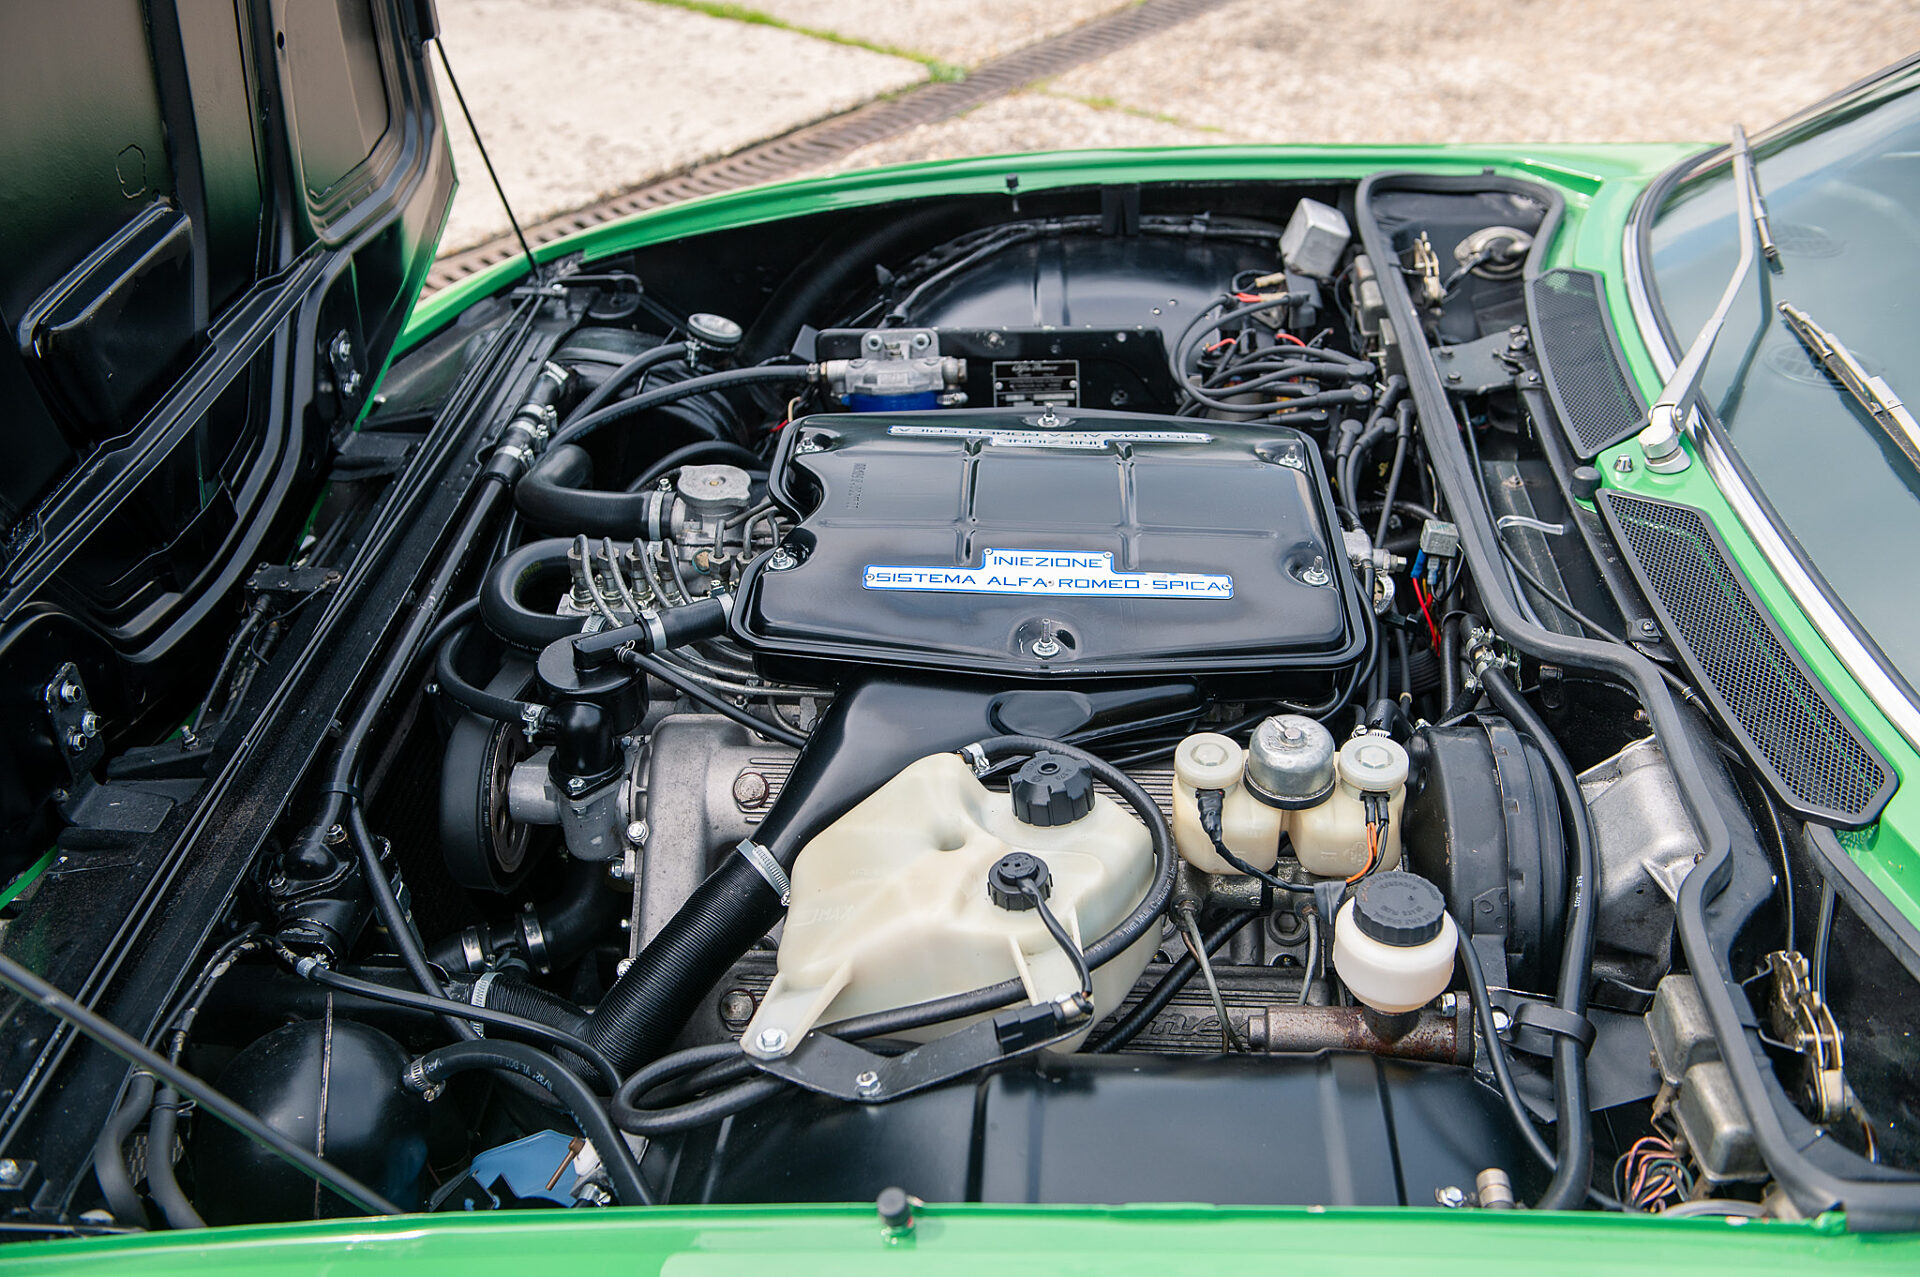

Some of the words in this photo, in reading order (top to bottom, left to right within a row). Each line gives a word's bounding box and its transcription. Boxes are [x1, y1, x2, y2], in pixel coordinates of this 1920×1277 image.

[994, 556, 1103, 568] INIEZIONE
[876, 572, 976, 584] SISTEMA
[987, 576, 1048, 587] ALFA
